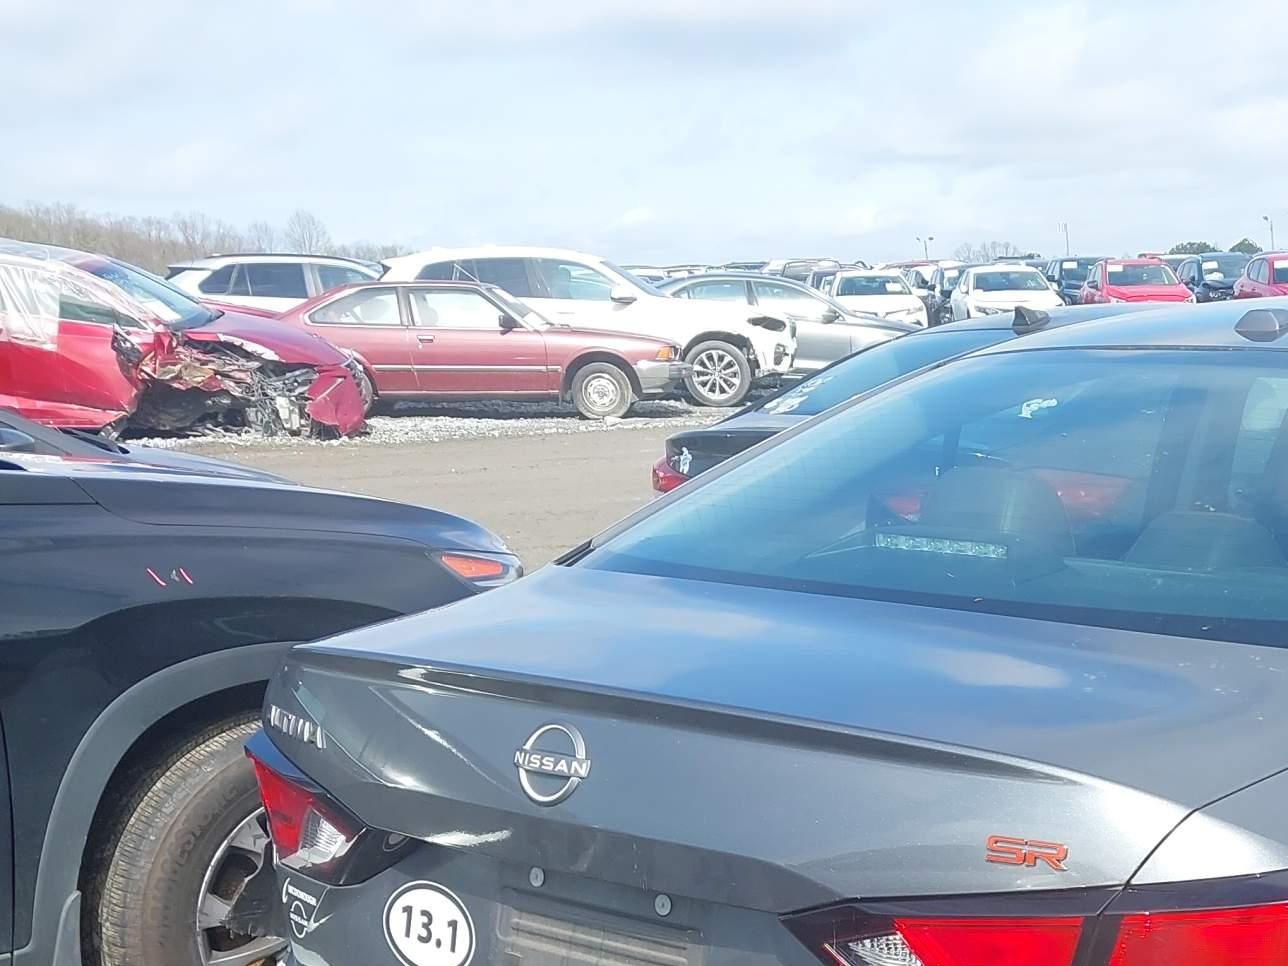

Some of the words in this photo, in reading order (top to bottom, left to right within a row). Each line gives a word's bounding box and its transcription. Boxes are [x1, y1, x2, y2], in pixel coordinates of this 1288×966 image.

[514, 750, 588, 777] NISSAN
[985, 834, 1069, 871] SR
[402, 905, 458, 953] 13.1
